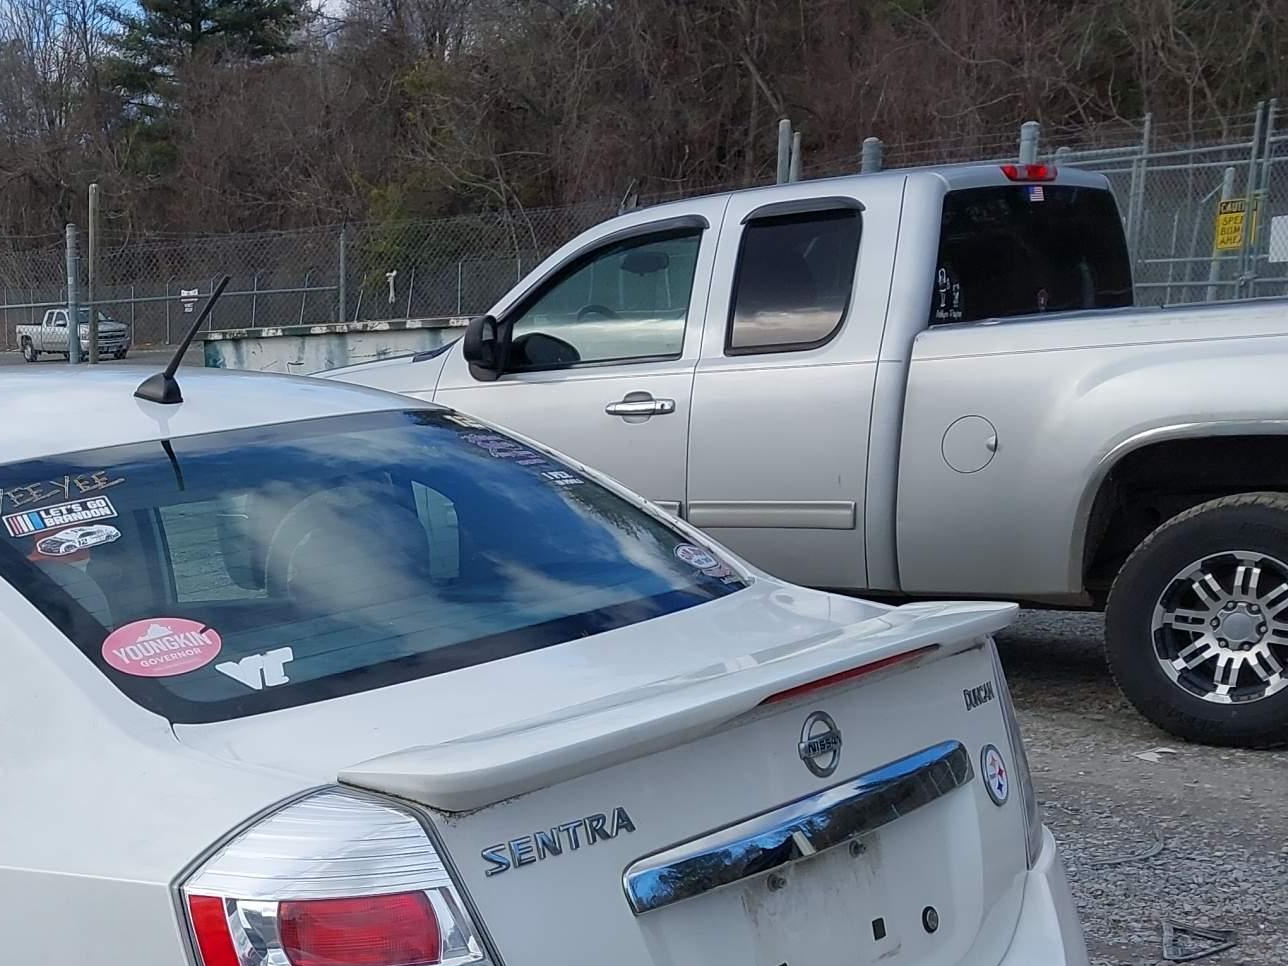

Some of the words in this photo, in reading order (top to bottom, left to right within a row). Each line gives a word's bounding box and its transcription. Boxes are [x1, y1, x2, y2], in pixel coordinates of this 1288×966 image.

[1221, 226, 1241, 236] BUM
[39, 503, 82, 519] LET'S
[86, 498, 107, 509] GO
[43, 506, 113, 527] BRANDON
[112, 631, 213, 664] YOUNGKIN
[139, 647, 203, 668] GOVERNOR
[481, 806, 637, 877] SENTRA
